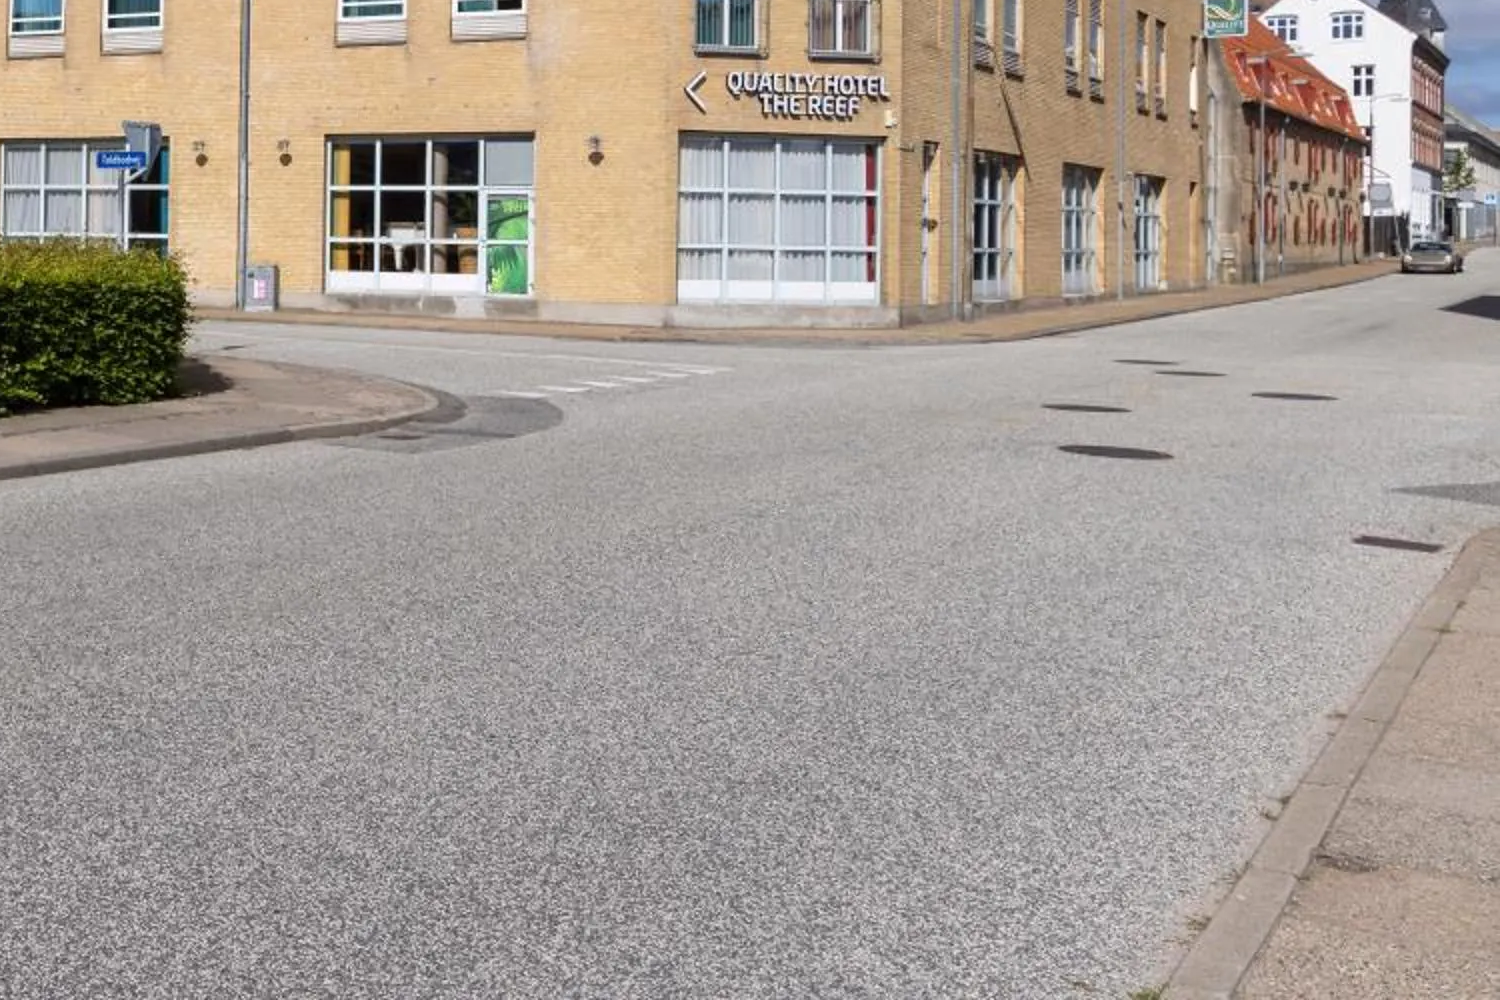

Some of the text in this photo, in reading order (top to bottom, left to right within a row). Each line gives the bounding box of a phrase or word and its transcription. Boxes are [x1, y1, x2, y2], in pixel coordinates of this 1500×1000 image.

[727, 71, 890, 97] QUALITY HOTEL
[759, 93, 861, 117] THE REEF
